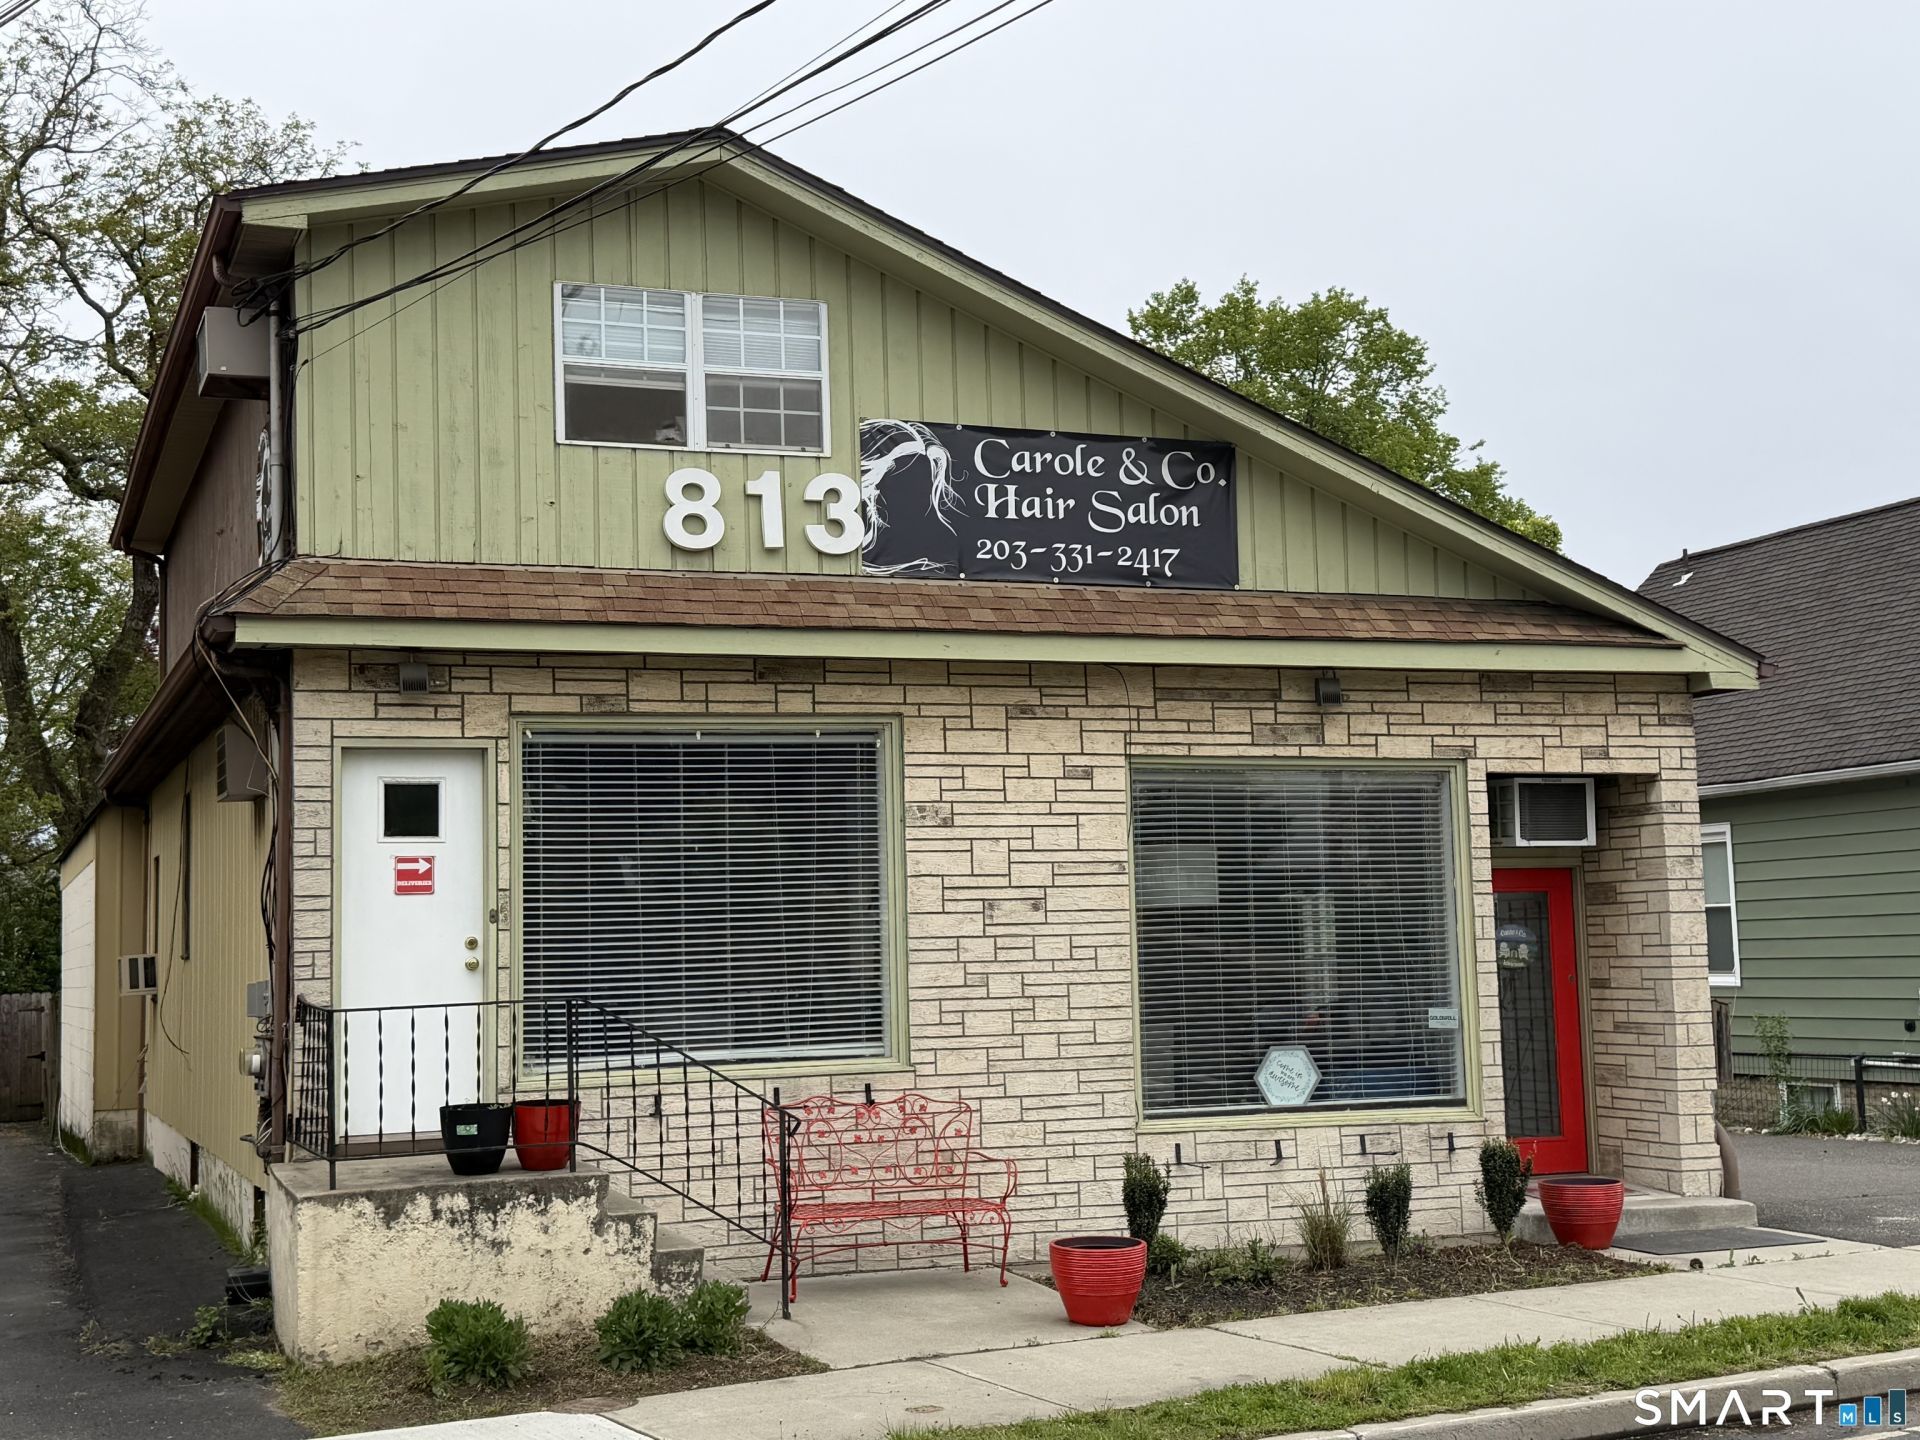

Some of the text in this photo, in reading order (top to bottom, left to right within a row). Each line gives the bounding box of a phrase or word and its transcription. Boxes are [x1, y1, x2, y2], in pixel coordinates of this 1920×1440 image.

[974, 438, 1227, 490] Carole & Co.
[663, 468, 866, 556] 813
[974, 483, 1201, 533] Hair Salon
[976, 539, 1181, 578] 203-331-2417
